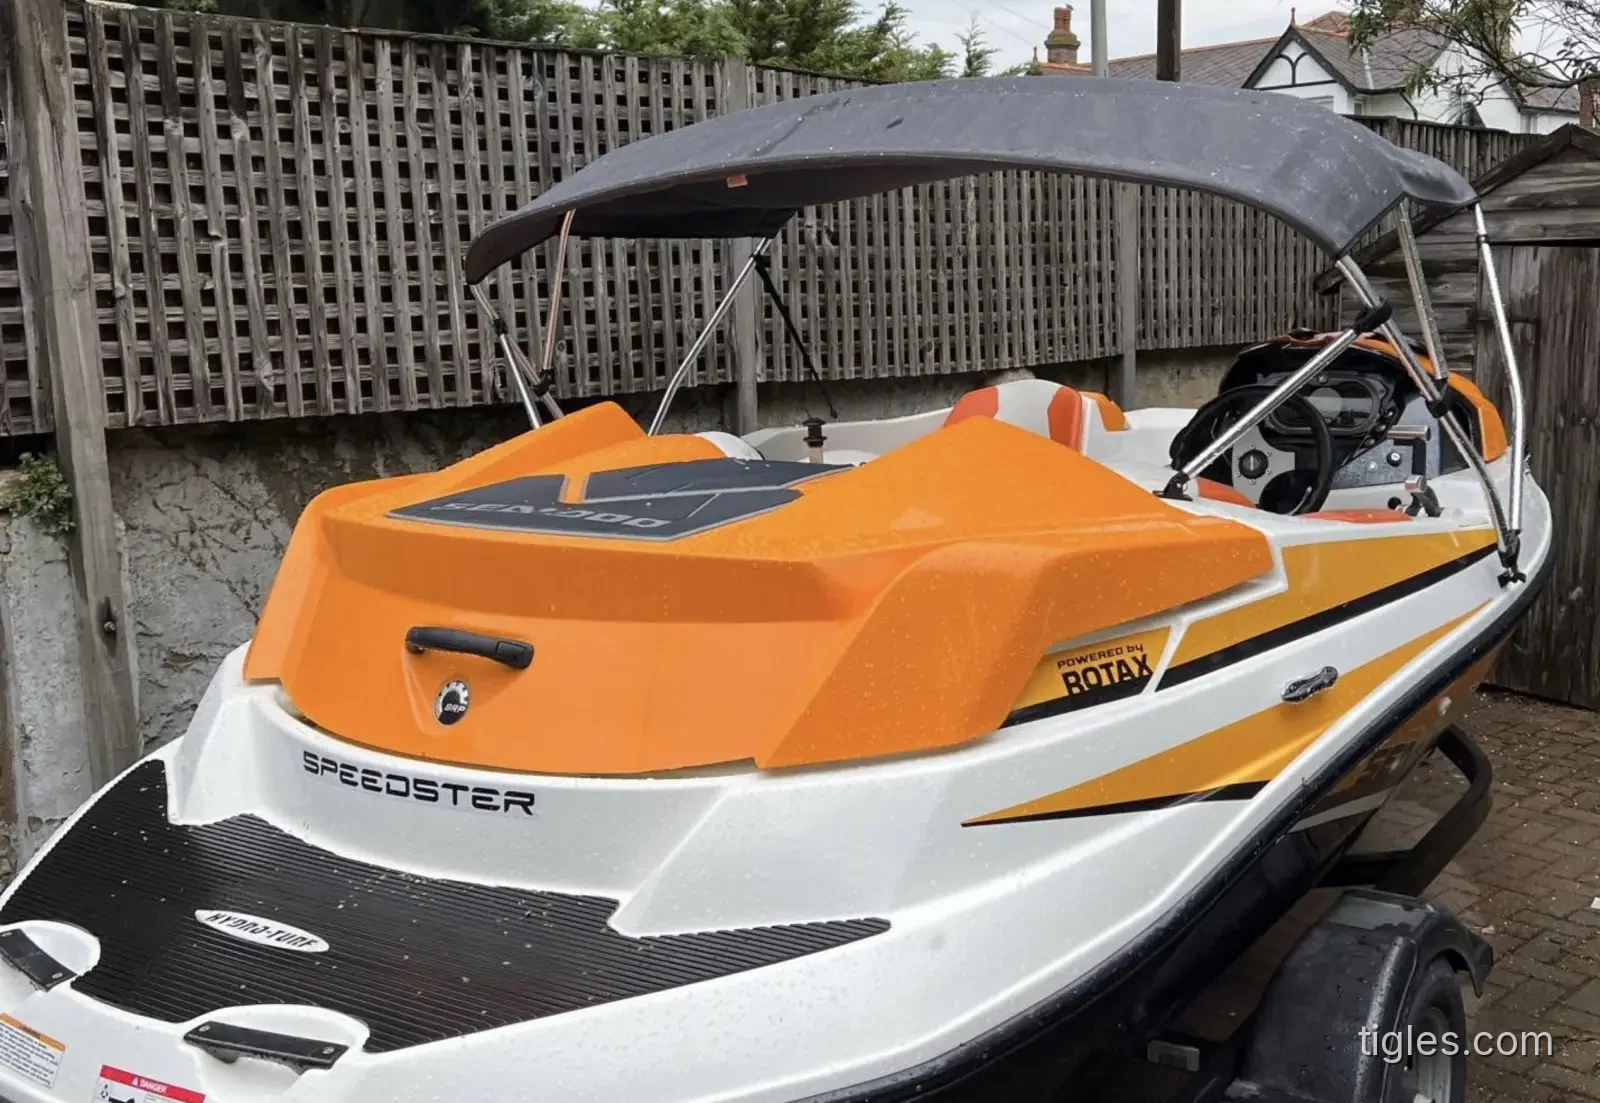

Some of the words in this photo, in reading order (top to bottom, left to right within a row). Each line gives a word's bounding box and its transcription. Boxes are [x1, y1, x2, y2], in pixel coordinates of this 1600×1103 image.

[1057, 647, 1123, 669] POWERED
[1127, 644, 1144, 653] by
[1062, 654, 1153, 696] ROTAX
[444, 703, 466, 713] BRP
[303, 751, 535, 815] SPEEDSTER
[205, 912, 318, 948] HYDRO-TURF
[139, 1078, 168, 1094] DANGER
